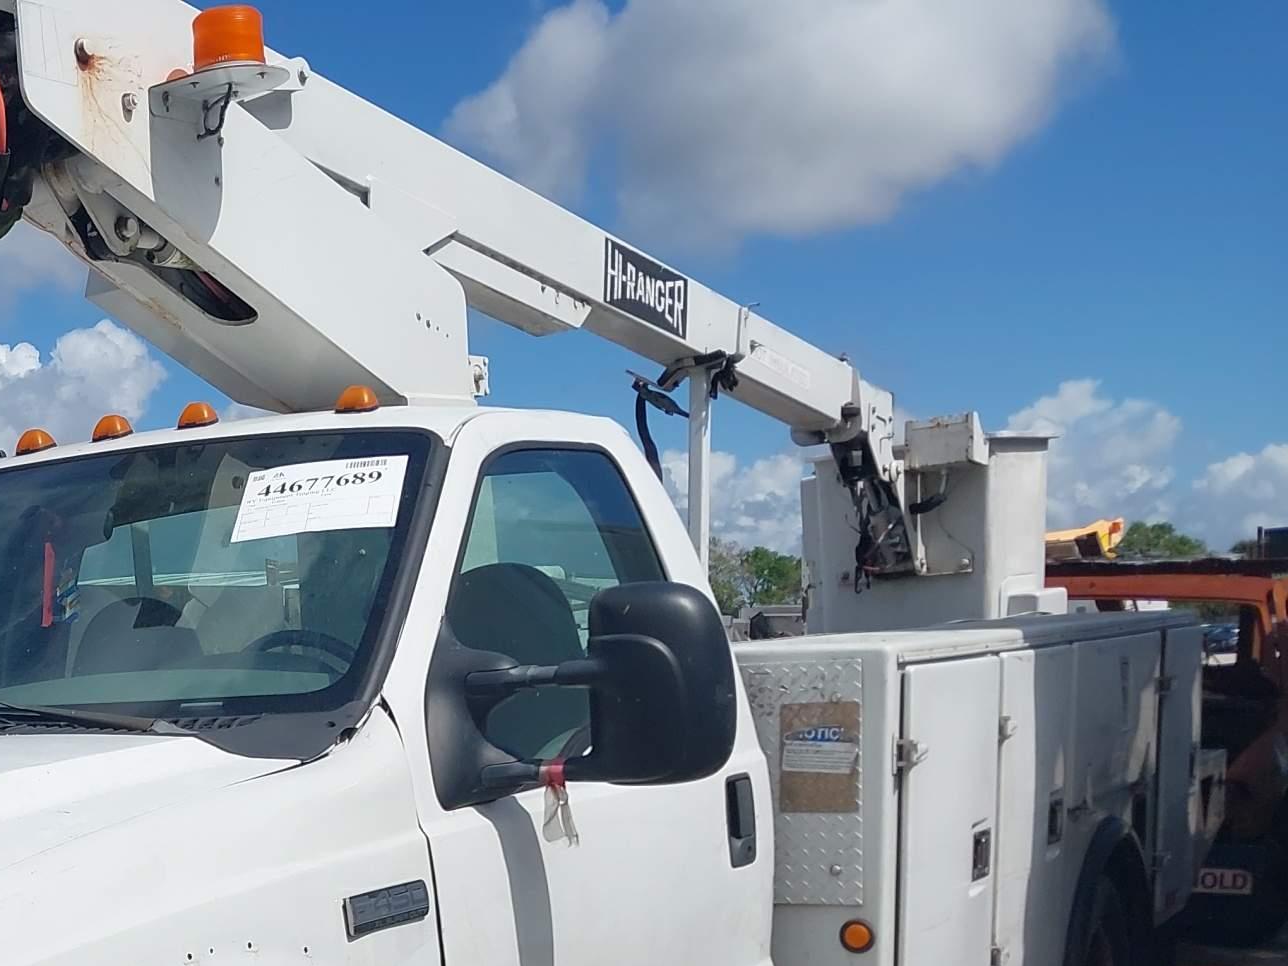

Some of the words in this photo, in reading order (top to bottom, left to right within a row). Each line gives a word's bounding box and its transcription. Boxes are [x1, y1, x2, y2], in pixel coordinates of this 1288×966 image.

[606, 239, 684, 337] HI-RANGER
[256, 470, 383, 498] 44677689
[799, 726, 844, 741] OTIC
[1195, 872, 1249, 890] OLD
